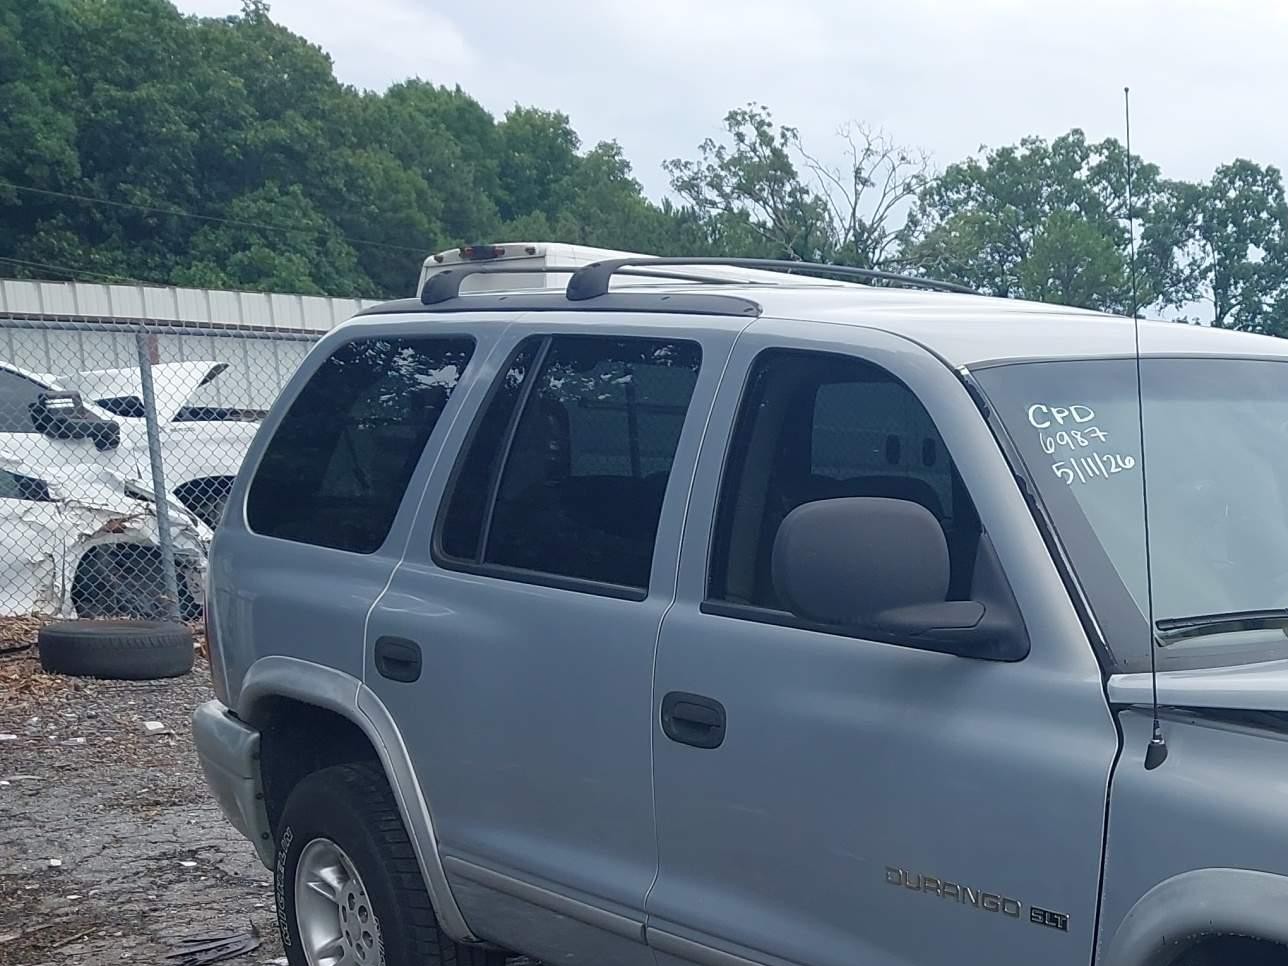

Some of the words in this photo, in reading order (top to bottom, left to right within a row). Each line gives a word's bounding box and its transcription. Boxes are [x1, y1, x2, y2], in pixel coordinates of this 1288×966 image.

[1028, 404, 1095, 428] CPD
[1039, 427, 1109, 454] 6987
[1052, 453, 1136, 485] 5/11/26
[885, 866, 1023, 920] DURANGO
[1030, 906, 1069, 932] SLT
